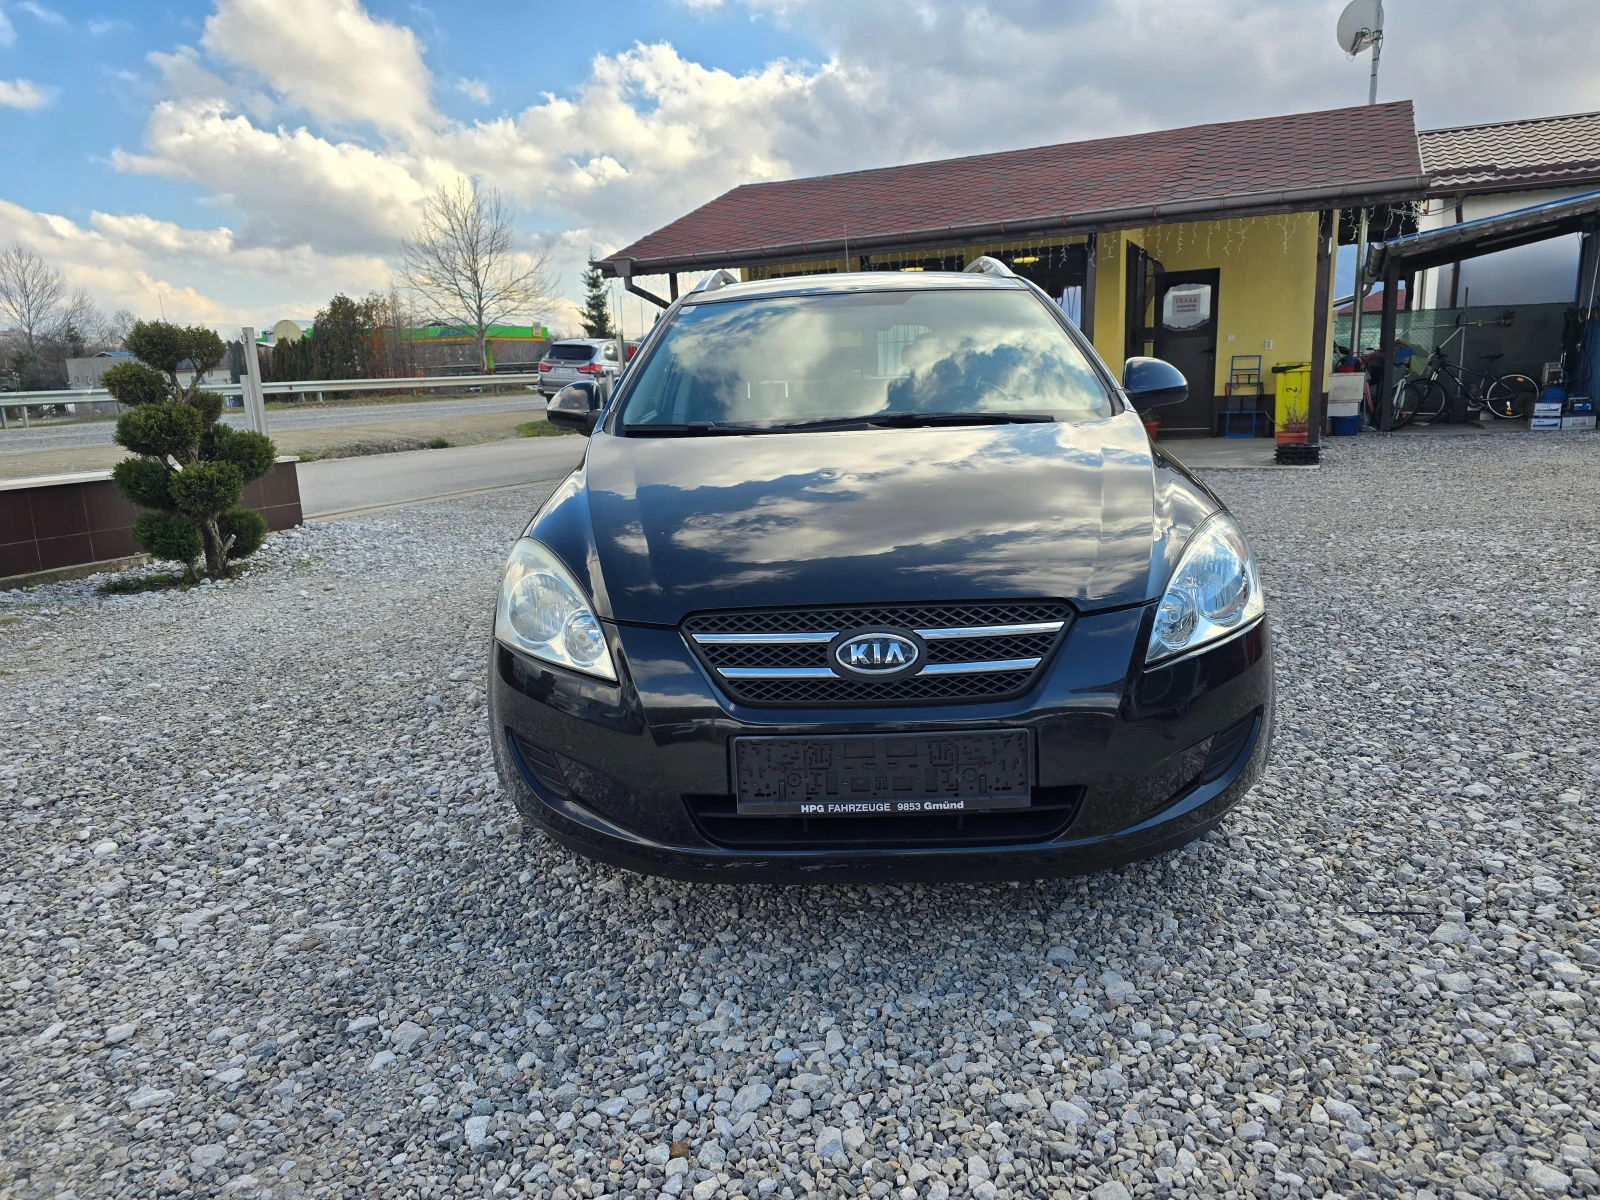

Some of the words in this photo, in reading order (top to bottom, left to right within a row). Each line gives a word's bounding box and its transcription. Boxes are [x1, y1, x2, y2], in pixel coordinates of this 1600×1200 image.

[849, 642, 906, 665] KIA
[800, 804, 825, 813] HPG
[828, 803, 891, 813] FAHRZEUGE
[897, 802, 921, 811] 9853
[923, 800, 964, 810] Gmünd
